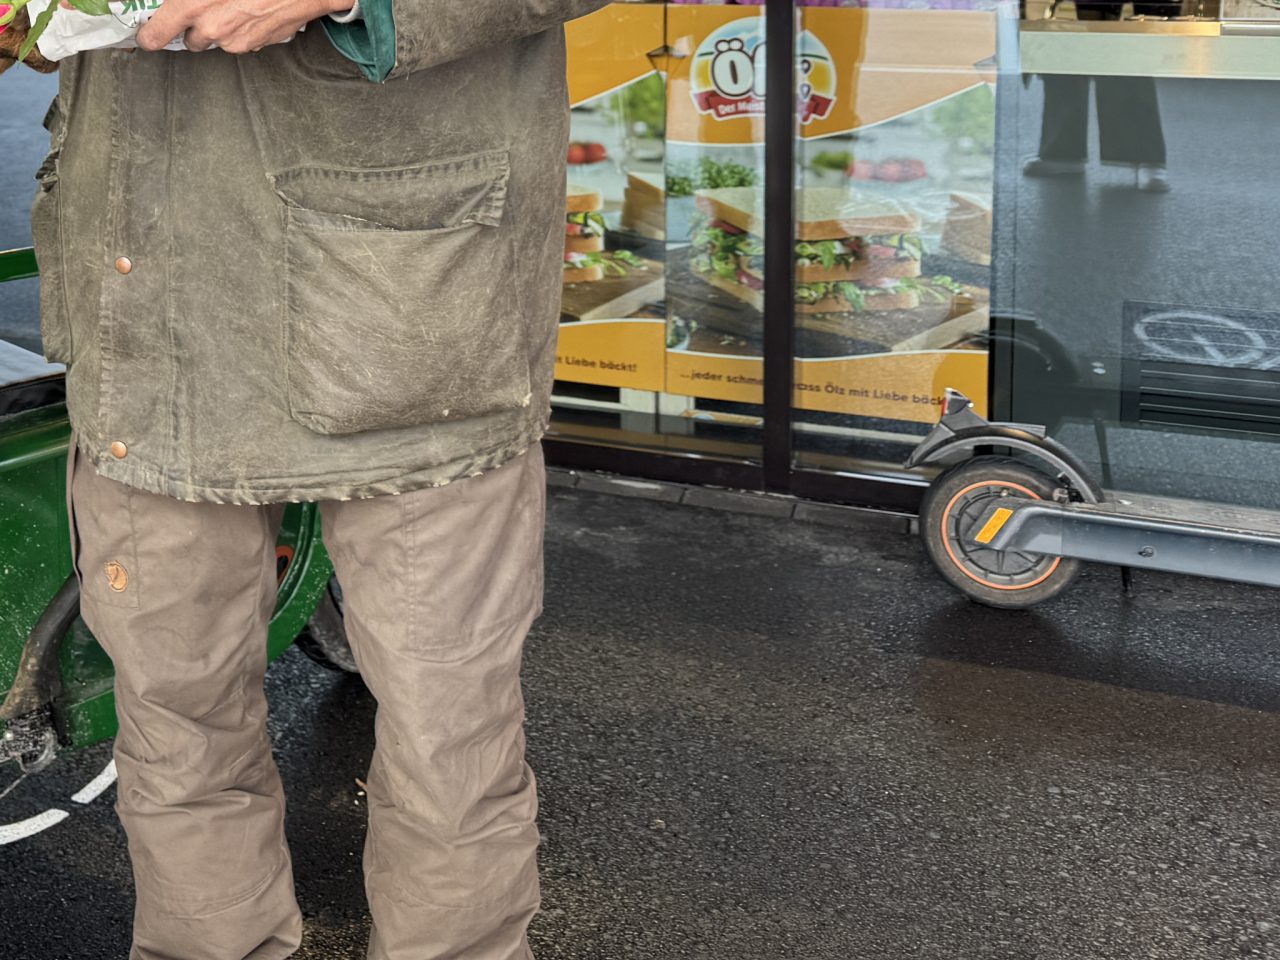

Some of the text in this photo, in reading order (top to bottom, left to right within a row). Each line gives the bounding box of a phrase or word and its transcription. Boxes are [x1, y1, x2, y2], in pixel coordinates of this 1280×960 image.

[565, 356, 596, 368] Liebe
[848, 388, 870, 398] mit
[873, 390, 909, 403] Liebe
